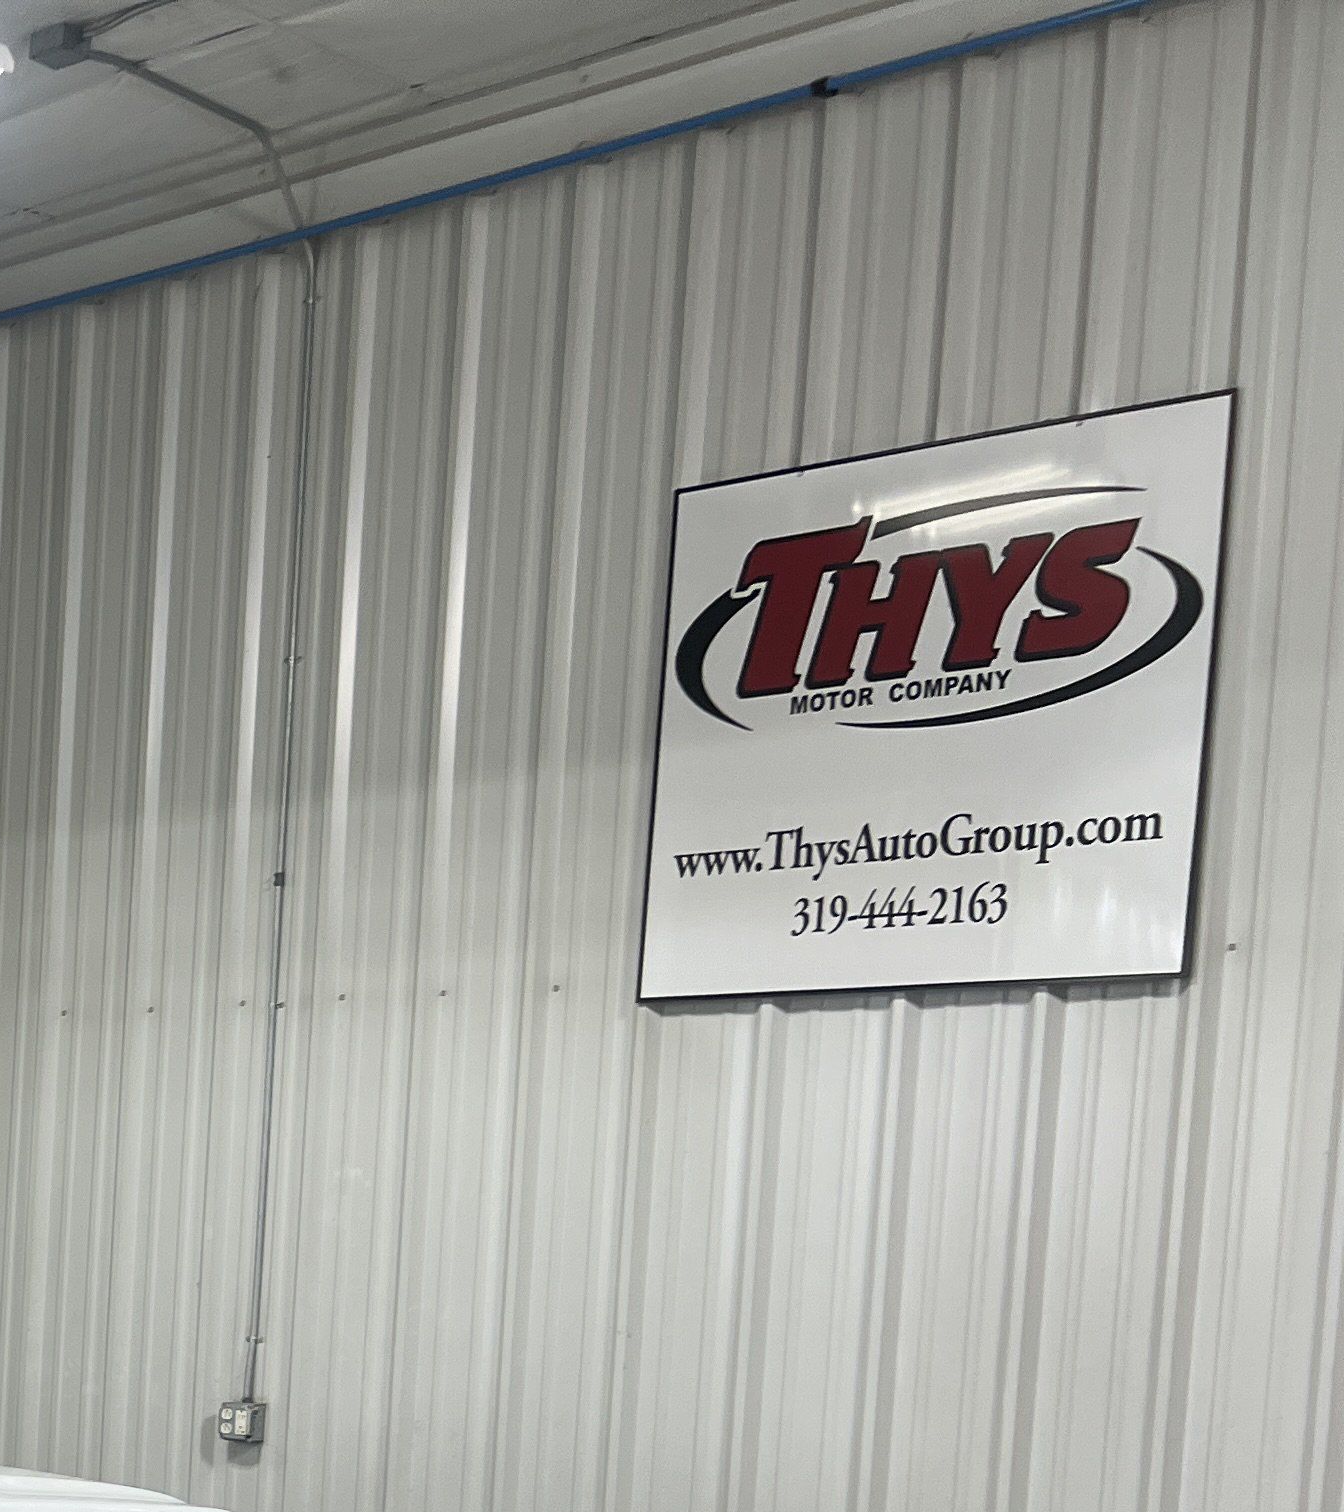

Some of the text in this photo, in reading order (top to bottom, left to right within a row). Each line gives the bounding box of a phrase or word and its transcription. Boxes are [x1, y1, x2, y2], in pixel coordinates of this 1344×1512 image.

[736, 515, 1142, 699] THYS
[789, 669, 1013, 715] MOTOR COMPANY
[674, 811, 1164, 881] www.ThysAutoGroup.com
[790, 882, 1008, 936] 319-444-2163
